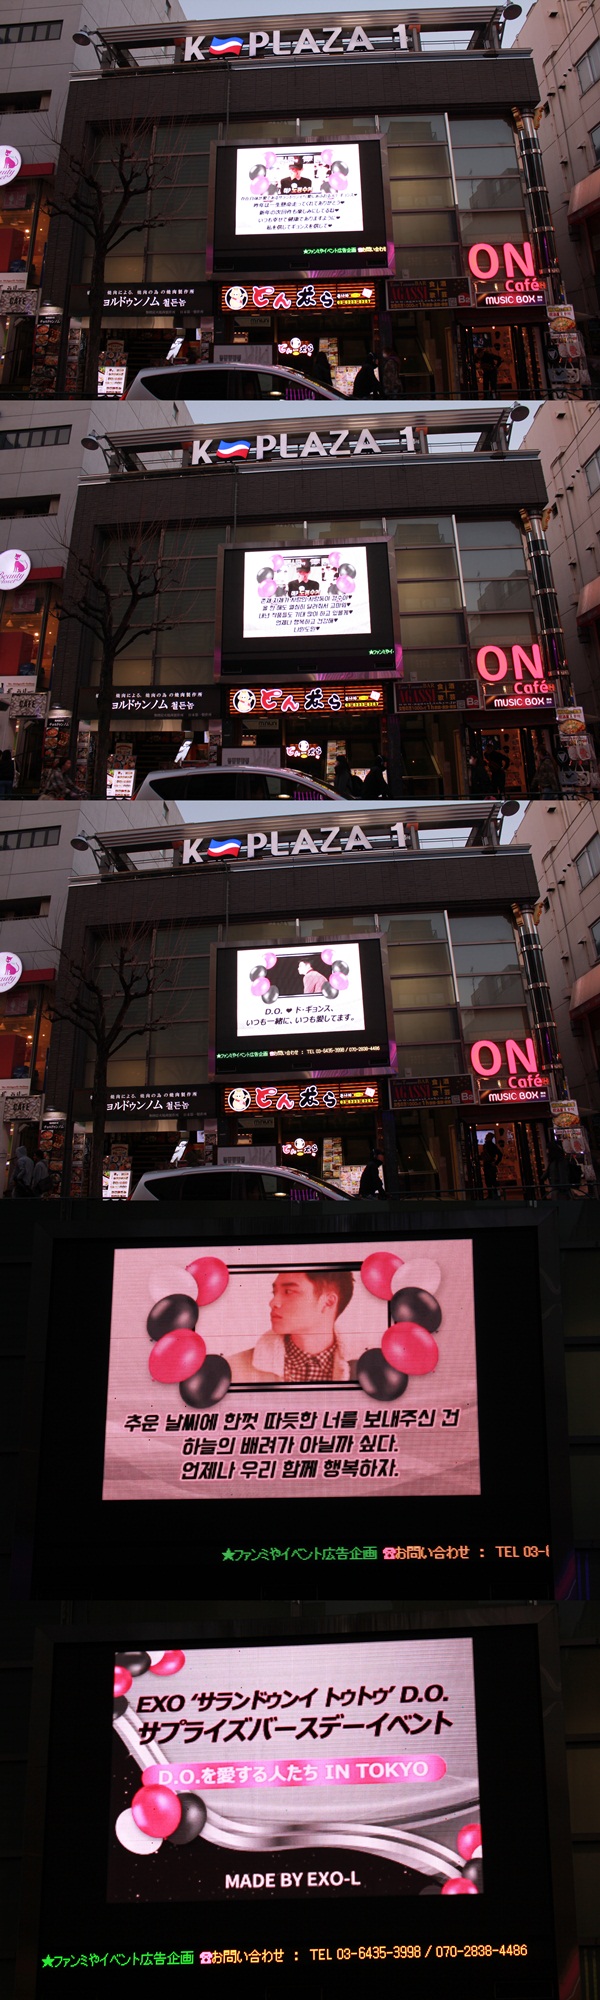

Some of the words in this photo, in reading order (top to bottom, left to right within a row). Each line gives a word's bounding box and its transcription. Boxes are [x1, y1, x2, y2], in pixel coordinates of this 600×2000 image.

[184, 36, 206, 61] K
[250, 26, 374, 57] PLAZA
[392, 24, 410, 50] 1
[468, 242, 535, 280] ON
[505, 278, 540, 292] Café
[485, 296, 514, 305] MUSIC
[516, 295, 536, 303] BOX
[190, 438, 212, 464] K
[257, 429, 381, 460] PLAZA
[400, 427, 416, 453] 1
[477, 644, 544, 682] ON
[514, 680, 548, 694] Café
[494, 698, 523, 707] MUSIC
[525, 697, 545, 705] BOX
[182, 838, 204, 864] K
[248, 826, 372, 858] PLAZA
[390, 822, 408, 850] 1
[471, 1038, 538, 1076] ON
[508, 1074, 542, 1088] Café
[488, 1092, 517, 1101] MUSIC
[519, 1091, 539, 1099] BOX
[124, 1414, 159, 1432] 추운
[165, 1413, 218, 1431] 날씨에
[224, 1413, 258, 1430] 한껏
[264, 1412, 317, 1430] 따듯한
[323, 1411, 358, 1428] 너를
[363, 1409, 436, 1427] 보내주신
[441, 1409, 459, 1426] 건
[182, 1437, 236, 1455] 하늘의
[240, 1436, 294, 1454] 배려가
[300, 1435, 353, 1453] 아닐까
[359, 1434, 399, 1452] 싶다.
[181, 1461, 235, 1480] 언제나
[240, 1460, 276, 1479] 우리
[281, 1460, 318, 1478] 함께
[324, 1459, 399, 1478] 행복하자.
[234, 1546, 378, 1561] ファンミやイベント広告企画
[396, 1545, 470, 1560] お問い合わせ
[496, 1546, 519, 1558] TEL
[137, 1694, 185, 1713] EXO
[400, 1684, 448, 1703] D.O.
[138, 1710, 453, 1745] サプライズバースデーイベント
[158, 1764, 318, 1785] D.O.を愛する人たち
[325, 1764, 349, 1780] IN
[356, 1762, 428, 1779] TOKYO
[225, 1873, 276, 1889] MADE
[281, 1872, 303, 1888] BY
[307, 1871, 361, 1886] EXO-L
[53, 1950, 194, 1968] ファンミやイベント広告企画
[211, 1949, 284, 1964] お問い合わせ
[310, 1948, 332, 1961] TEL
[336, 1946, 421, 1960] 03-6435-3998
[436, 1944, 528, 1958] 070-2838-4486
